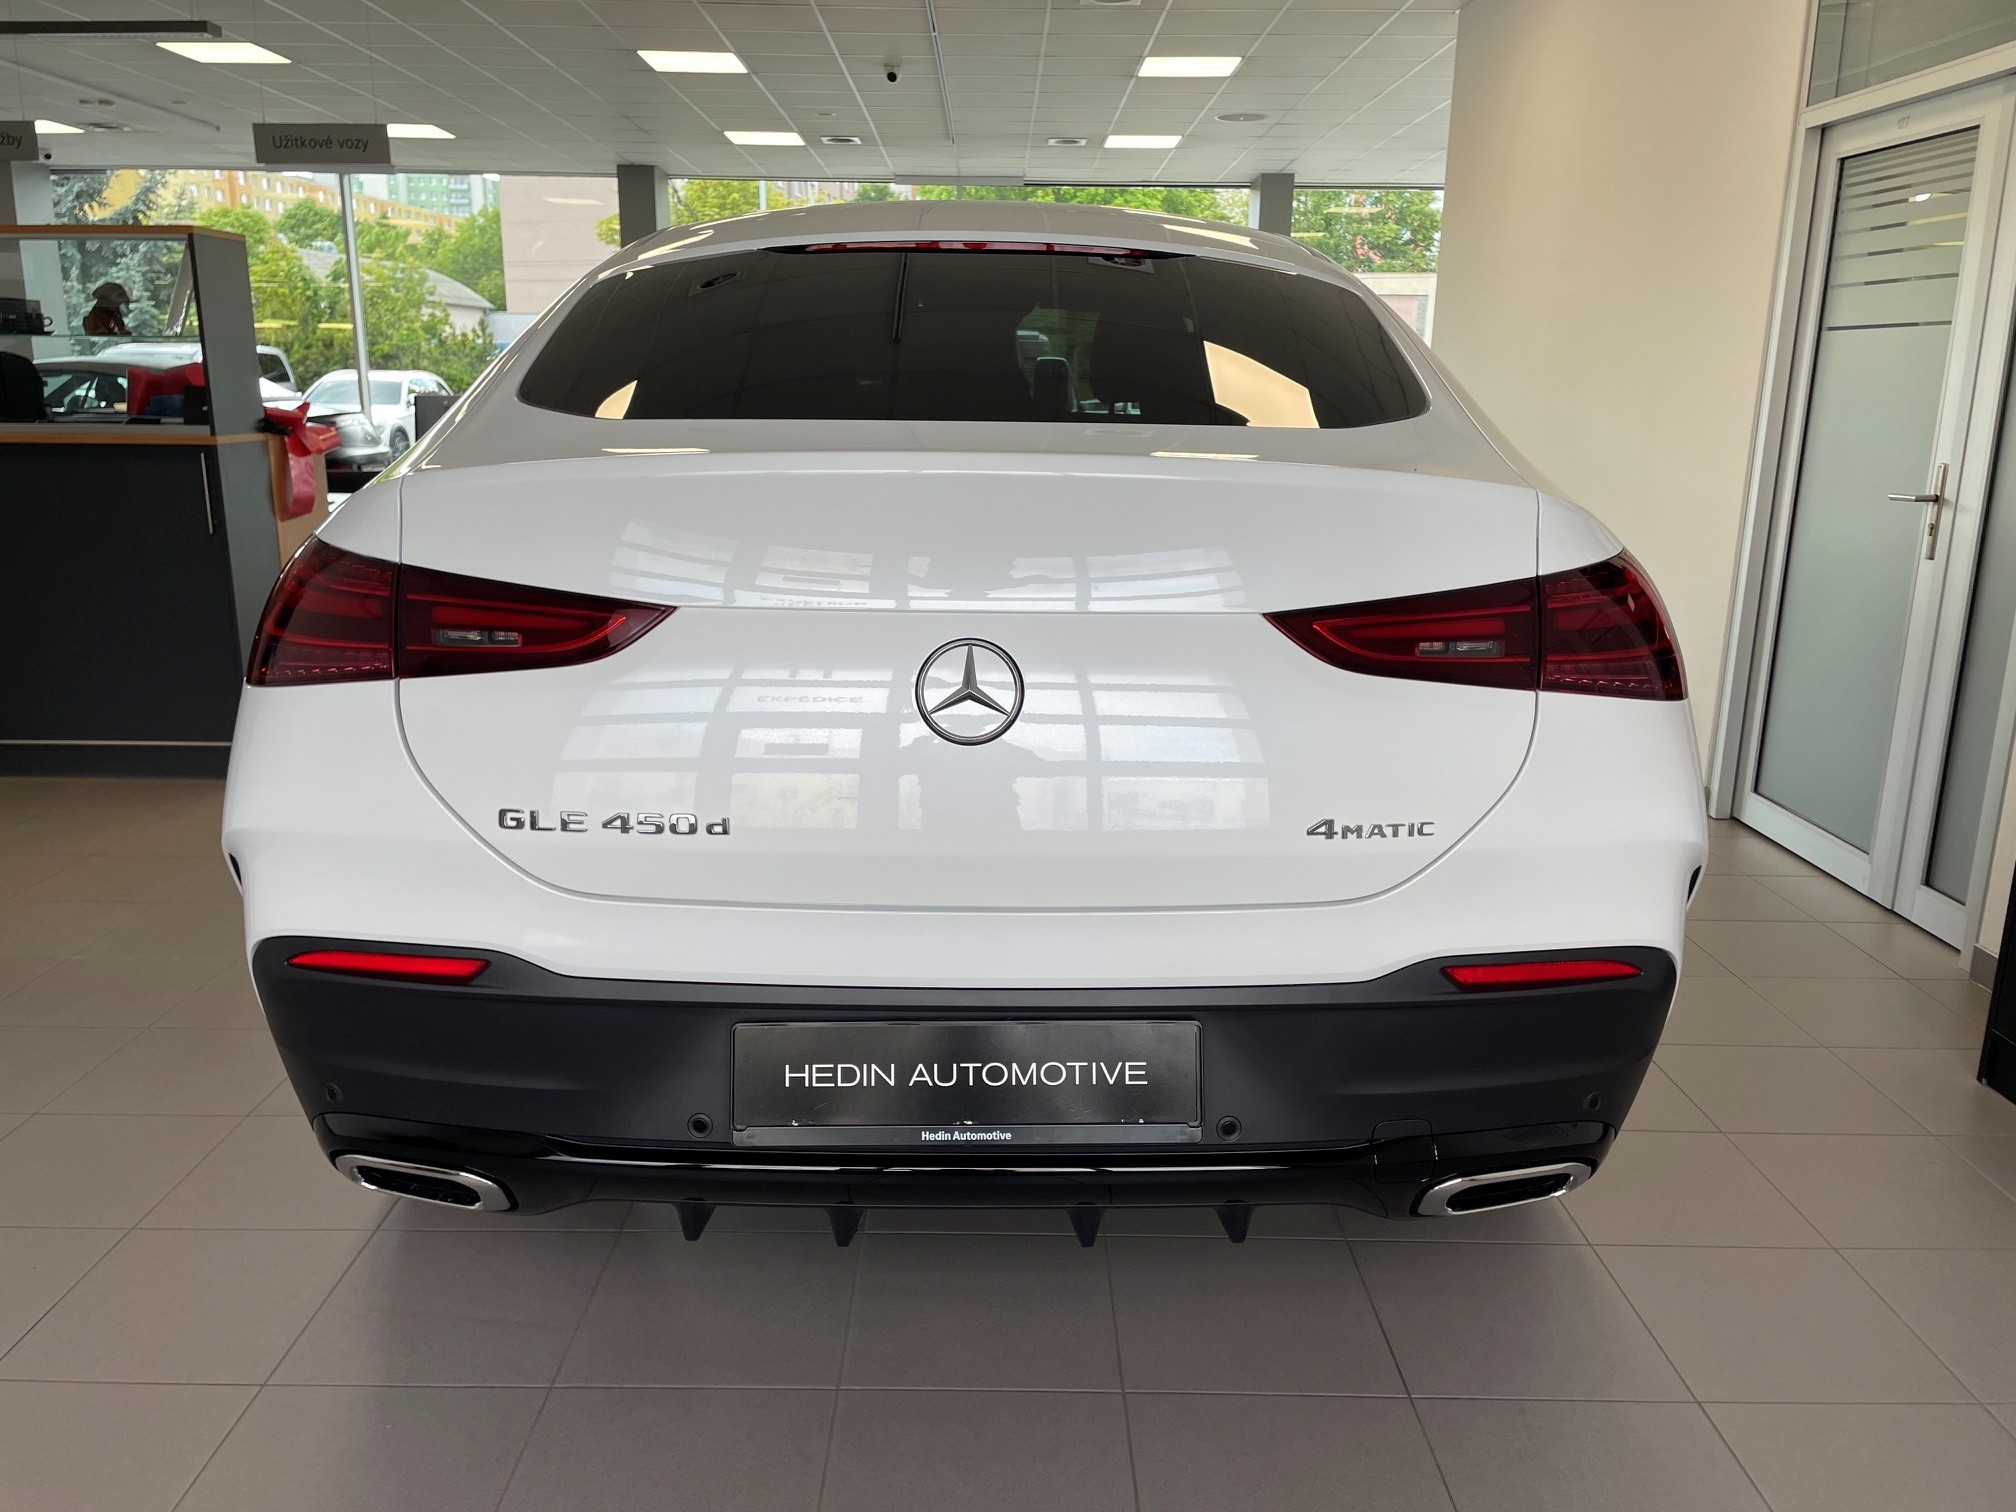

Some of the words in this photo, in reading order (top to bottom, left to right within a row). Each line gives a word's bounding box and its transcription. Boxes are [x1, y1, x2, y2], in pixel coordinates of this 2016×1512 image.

[271, 134, 333, 149] Užitkové
[337, 138, 369, 153] vozy
[498, 808, 588, 832] GLE
[1306, 818, 1435, 839] 4MATIC
[784, 1063, 896, 1088] HEDIN
[908, 1061, 1149, 1087] AUTOMOTIVE
[921, 1130, 951, 1141] Hedin
[952, 1130, 1012, 1140] Automotive
